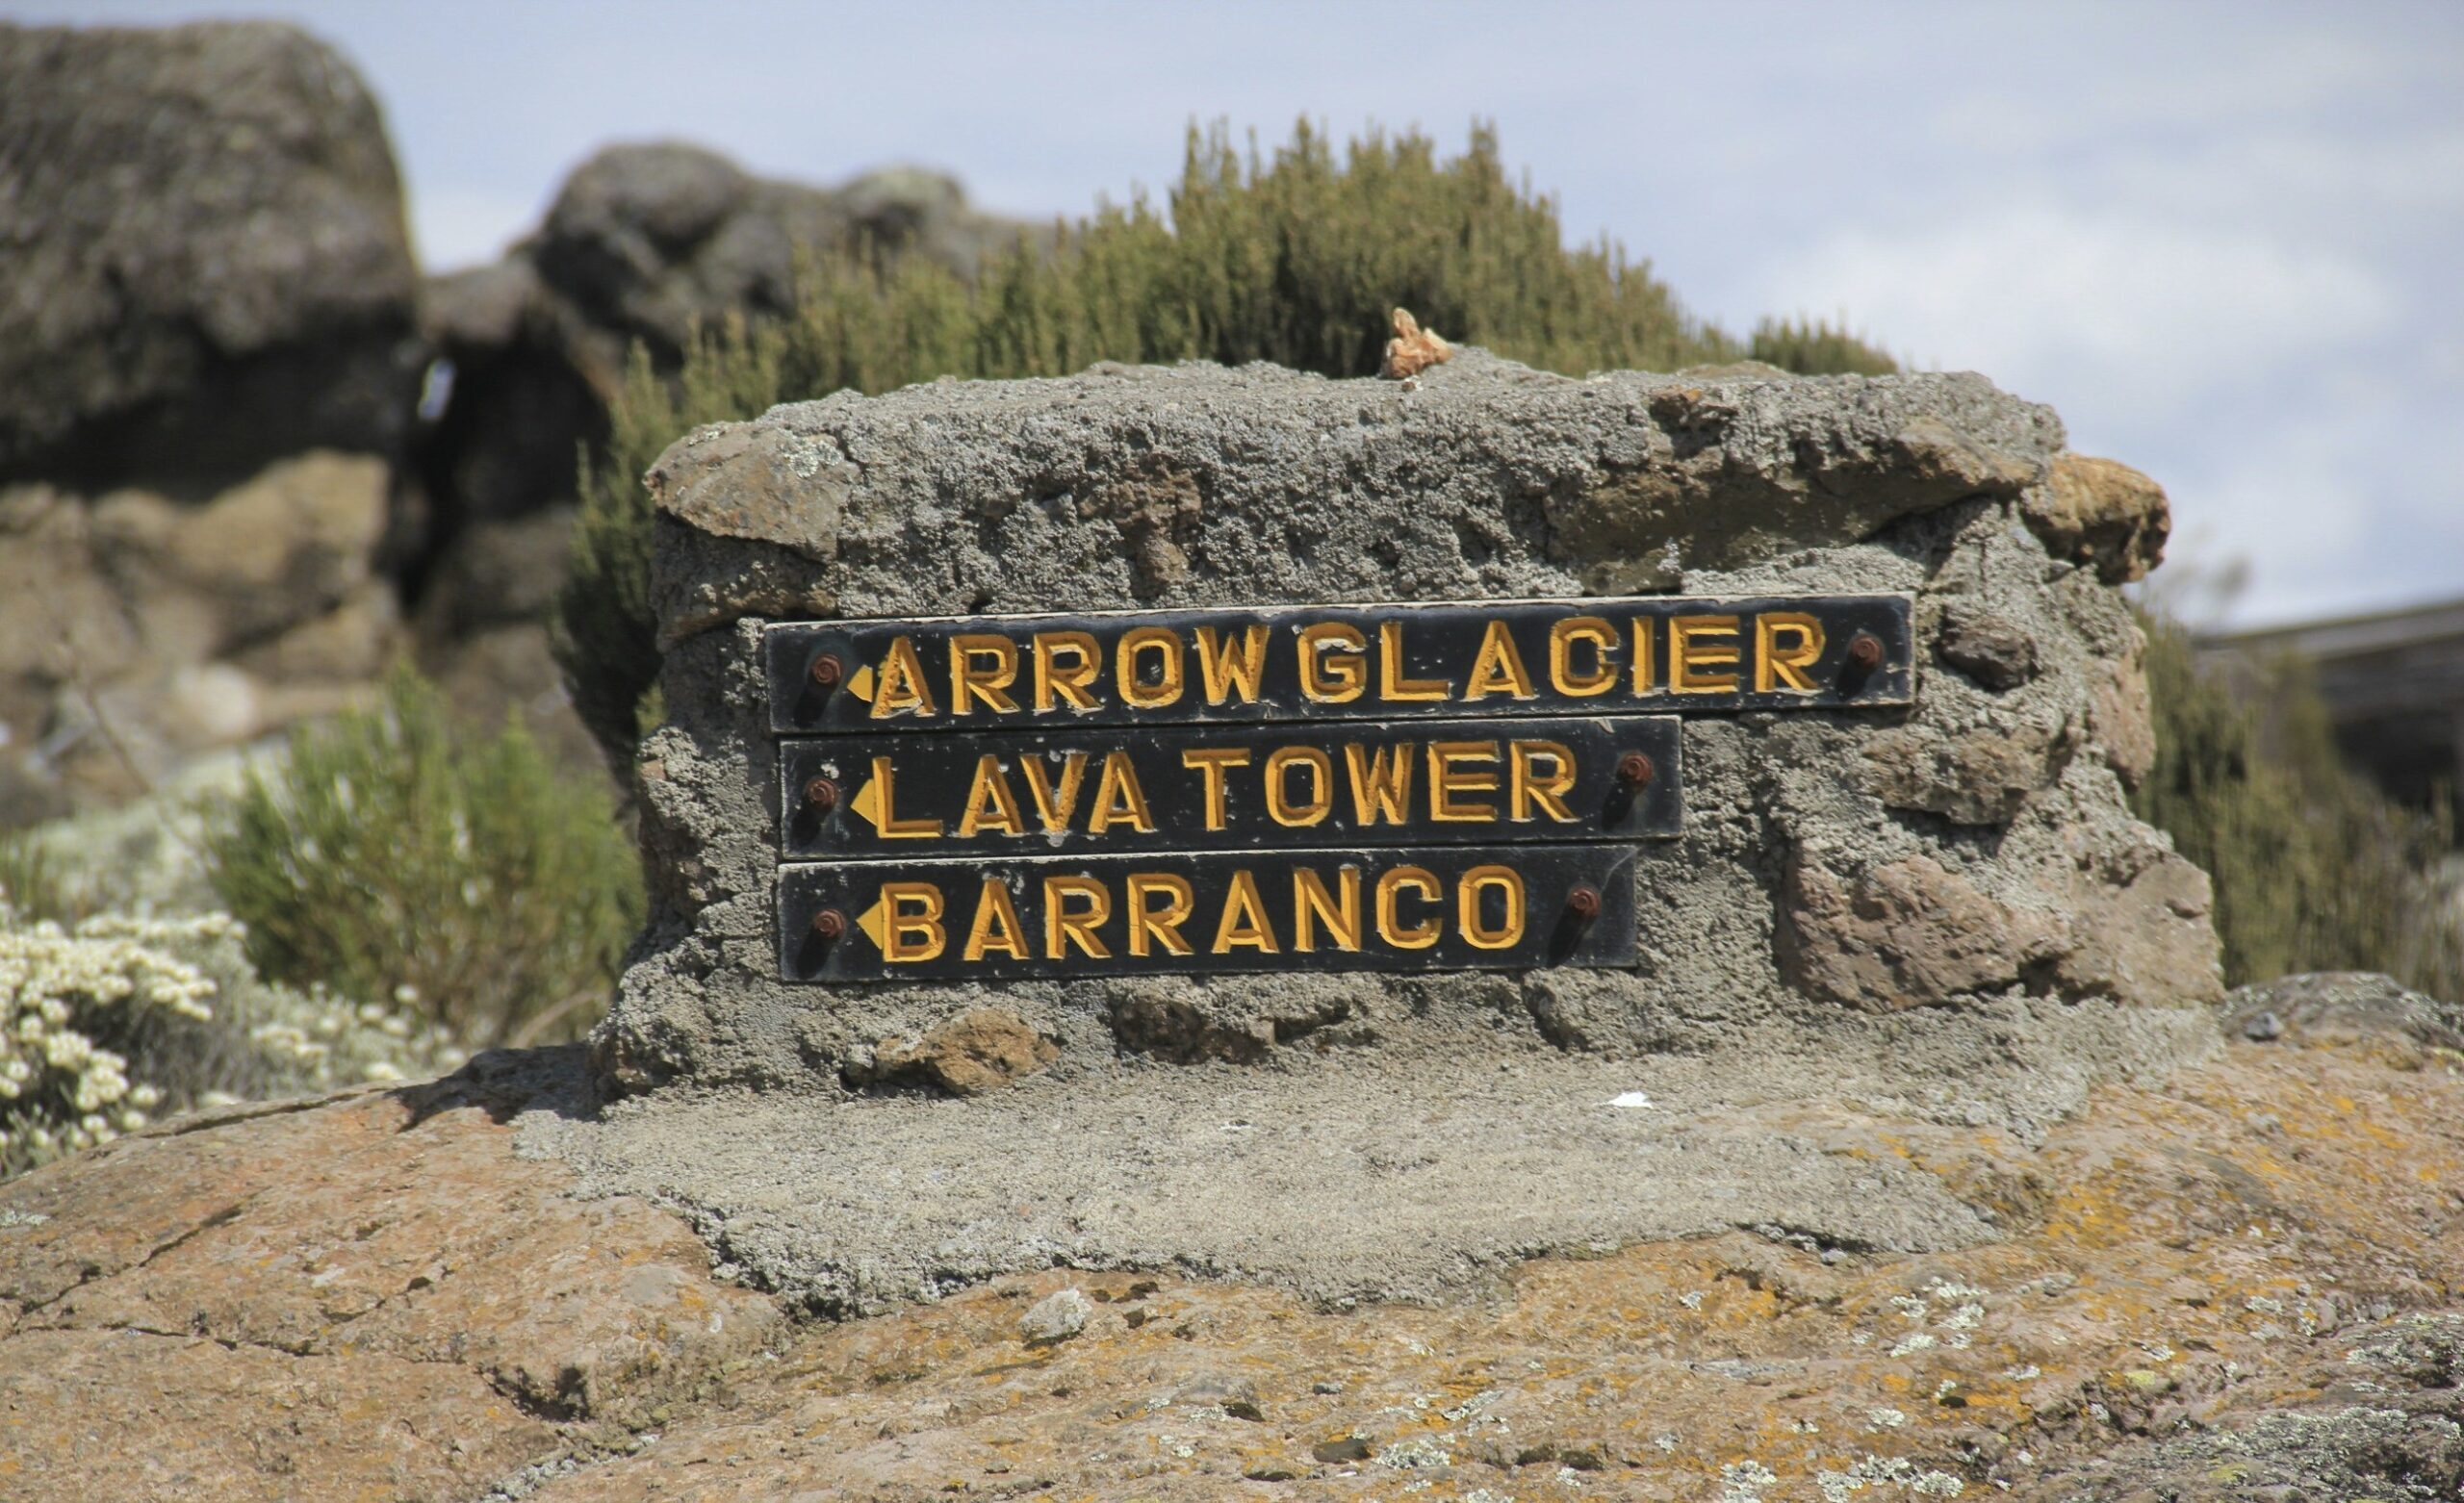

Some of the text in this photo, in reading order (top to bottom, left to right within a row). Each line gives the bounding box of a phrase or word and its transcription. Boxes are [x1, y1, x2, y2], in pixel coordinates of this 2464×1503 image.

[869, 612, 1825, 718] ARROW GLACIER
[872, 740, 1579, 839] LAVA TOWER
[882, 865, 1526, 962] BARRANCO
